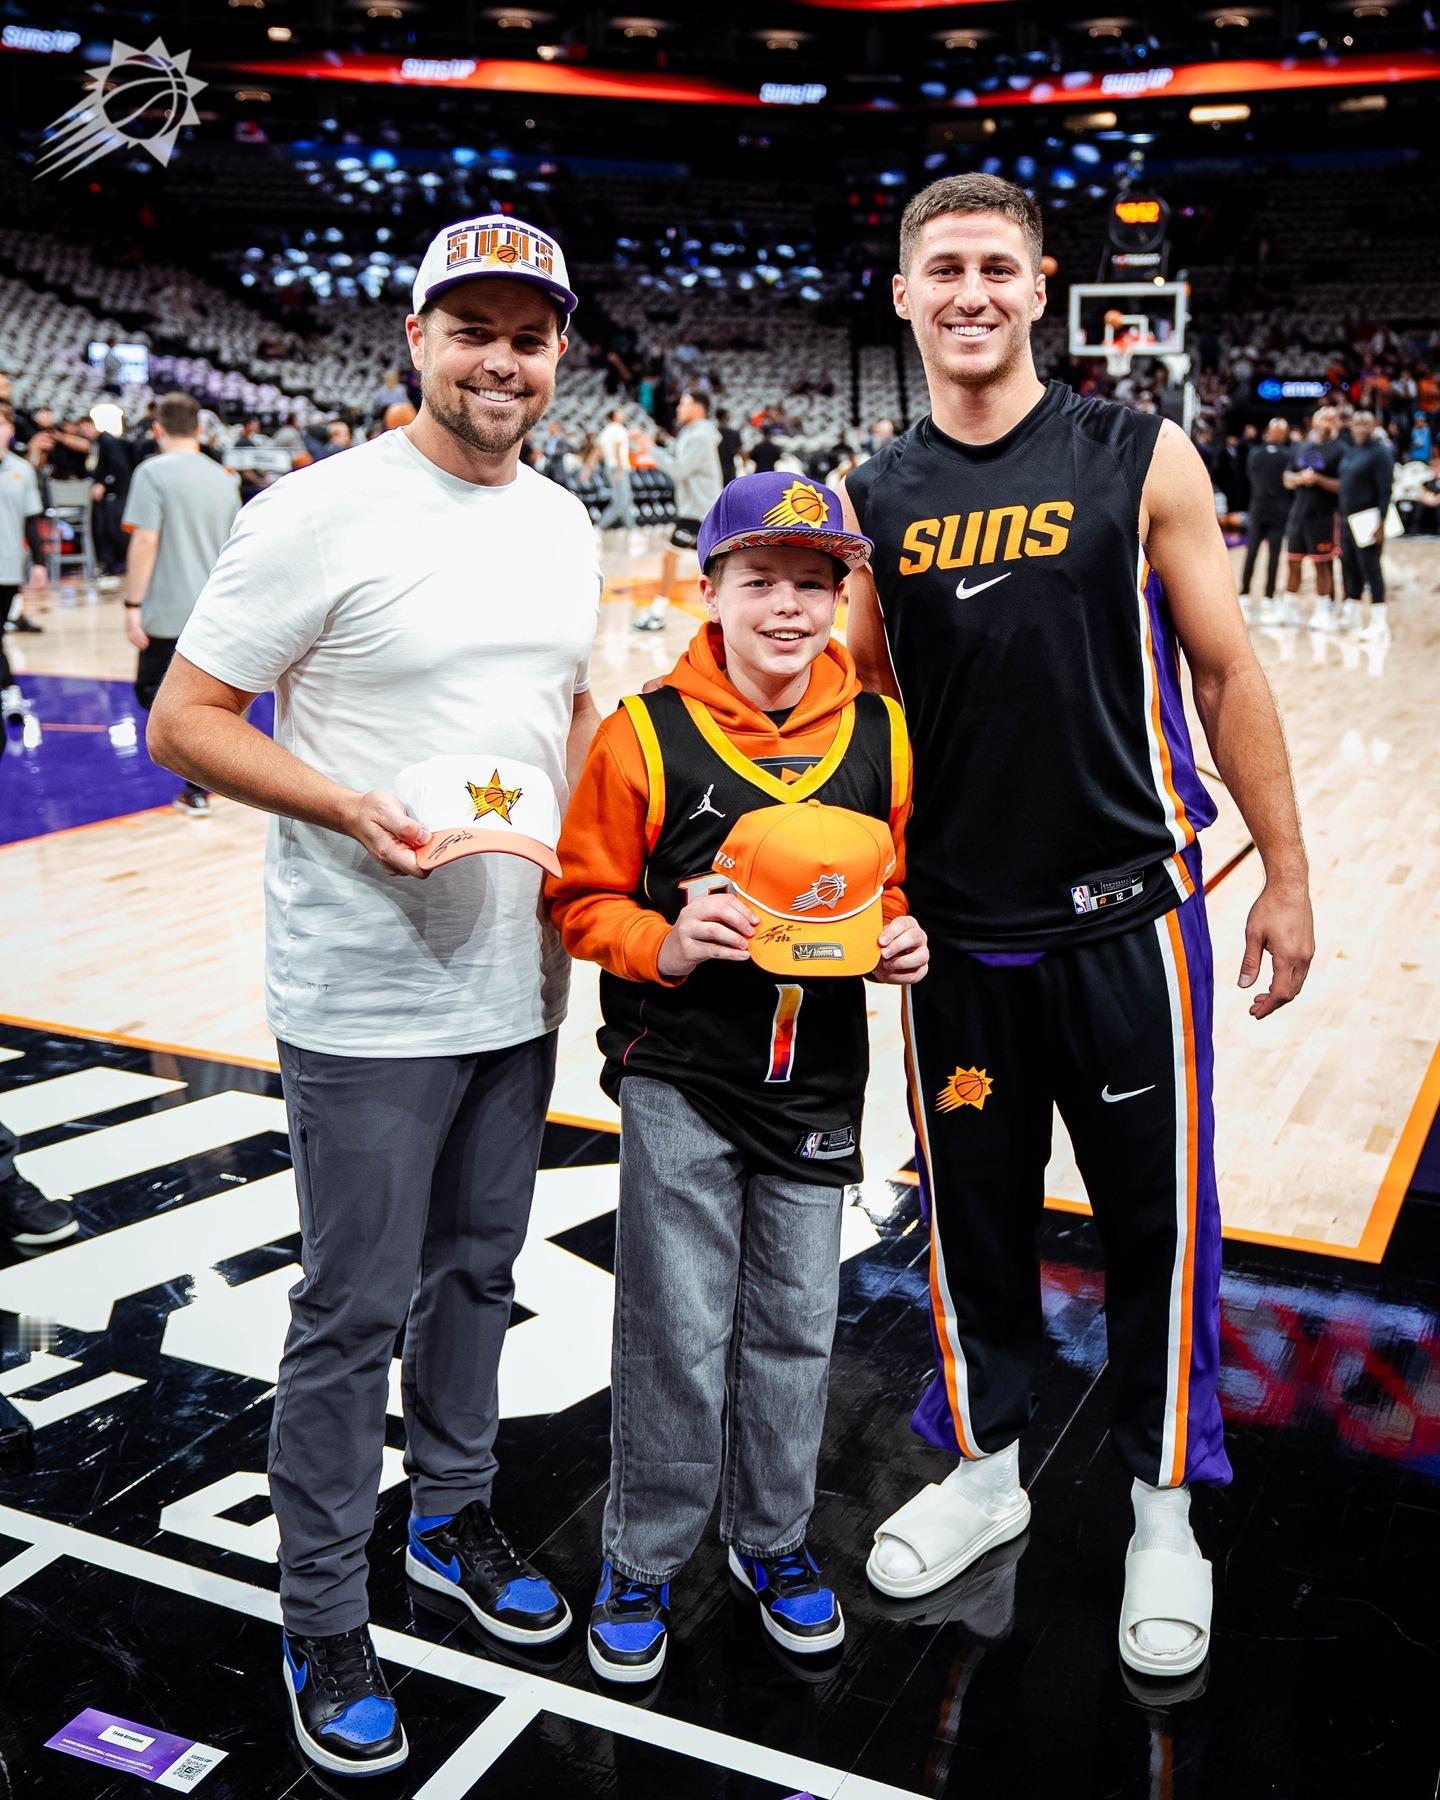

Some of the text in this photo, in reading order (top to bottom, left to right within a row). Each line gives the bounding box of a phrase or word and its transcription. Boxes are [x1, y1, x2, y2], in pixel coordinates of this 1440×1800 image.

[446, 229, 554, 276] SUNS
[461, 223, 543, 241] PHOENIX
[899, 500, 1075, 576] SUNS
[1116, 892, 1124, 901] 12
[764, 984, 804, 1083] 1
